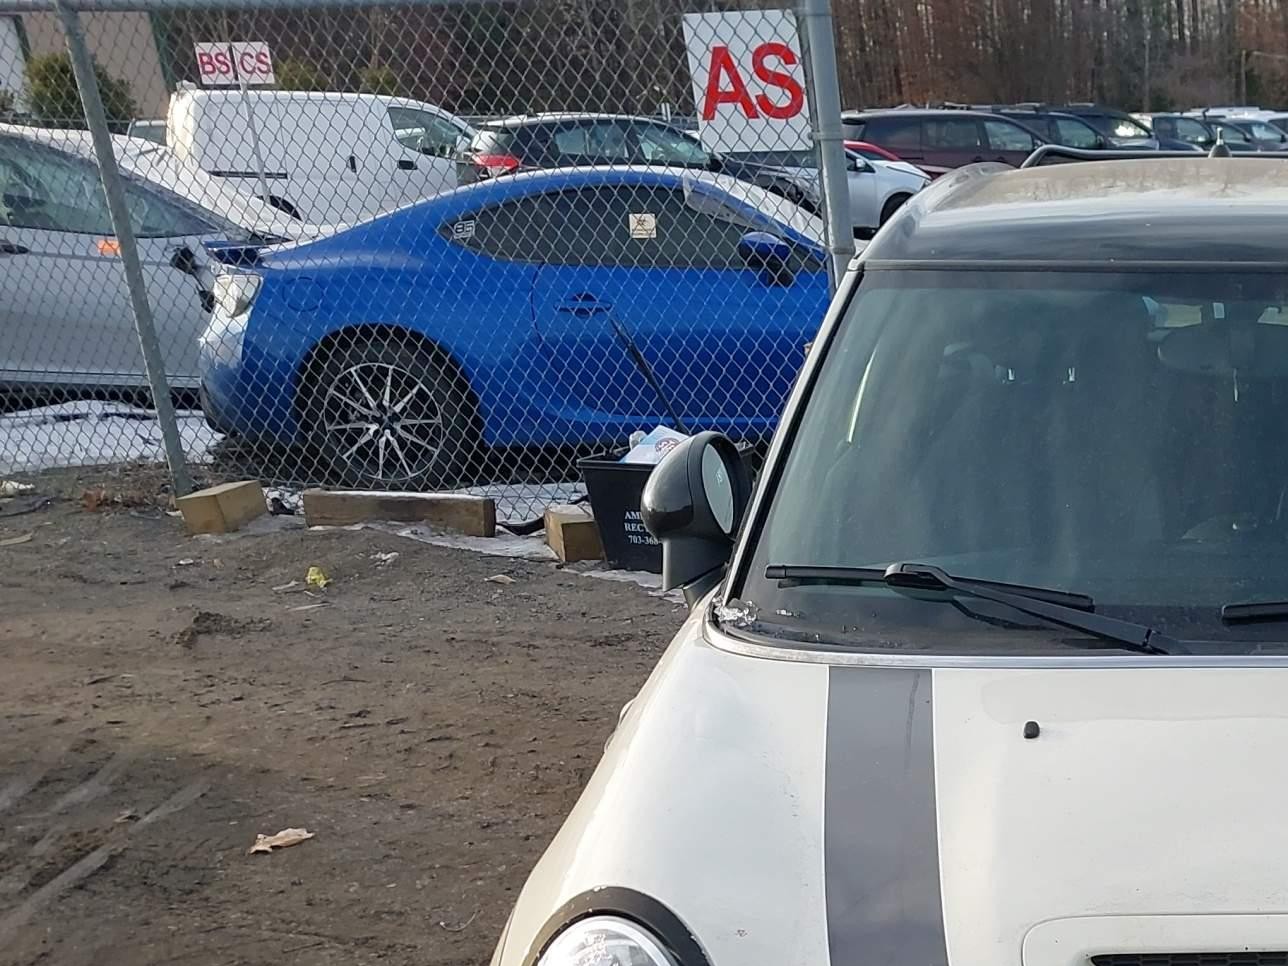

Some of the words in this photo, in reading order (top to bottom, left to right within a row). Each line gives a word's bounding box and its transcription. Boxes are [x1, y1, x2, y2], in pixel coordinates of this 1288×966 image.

[198, 52, 231, 75] BS
[240, 52, 272, 75] CS
[702, 42, 805, 121] AS
[624, 511, 642, 520] AM
[624, 522, 646, 532] REC
